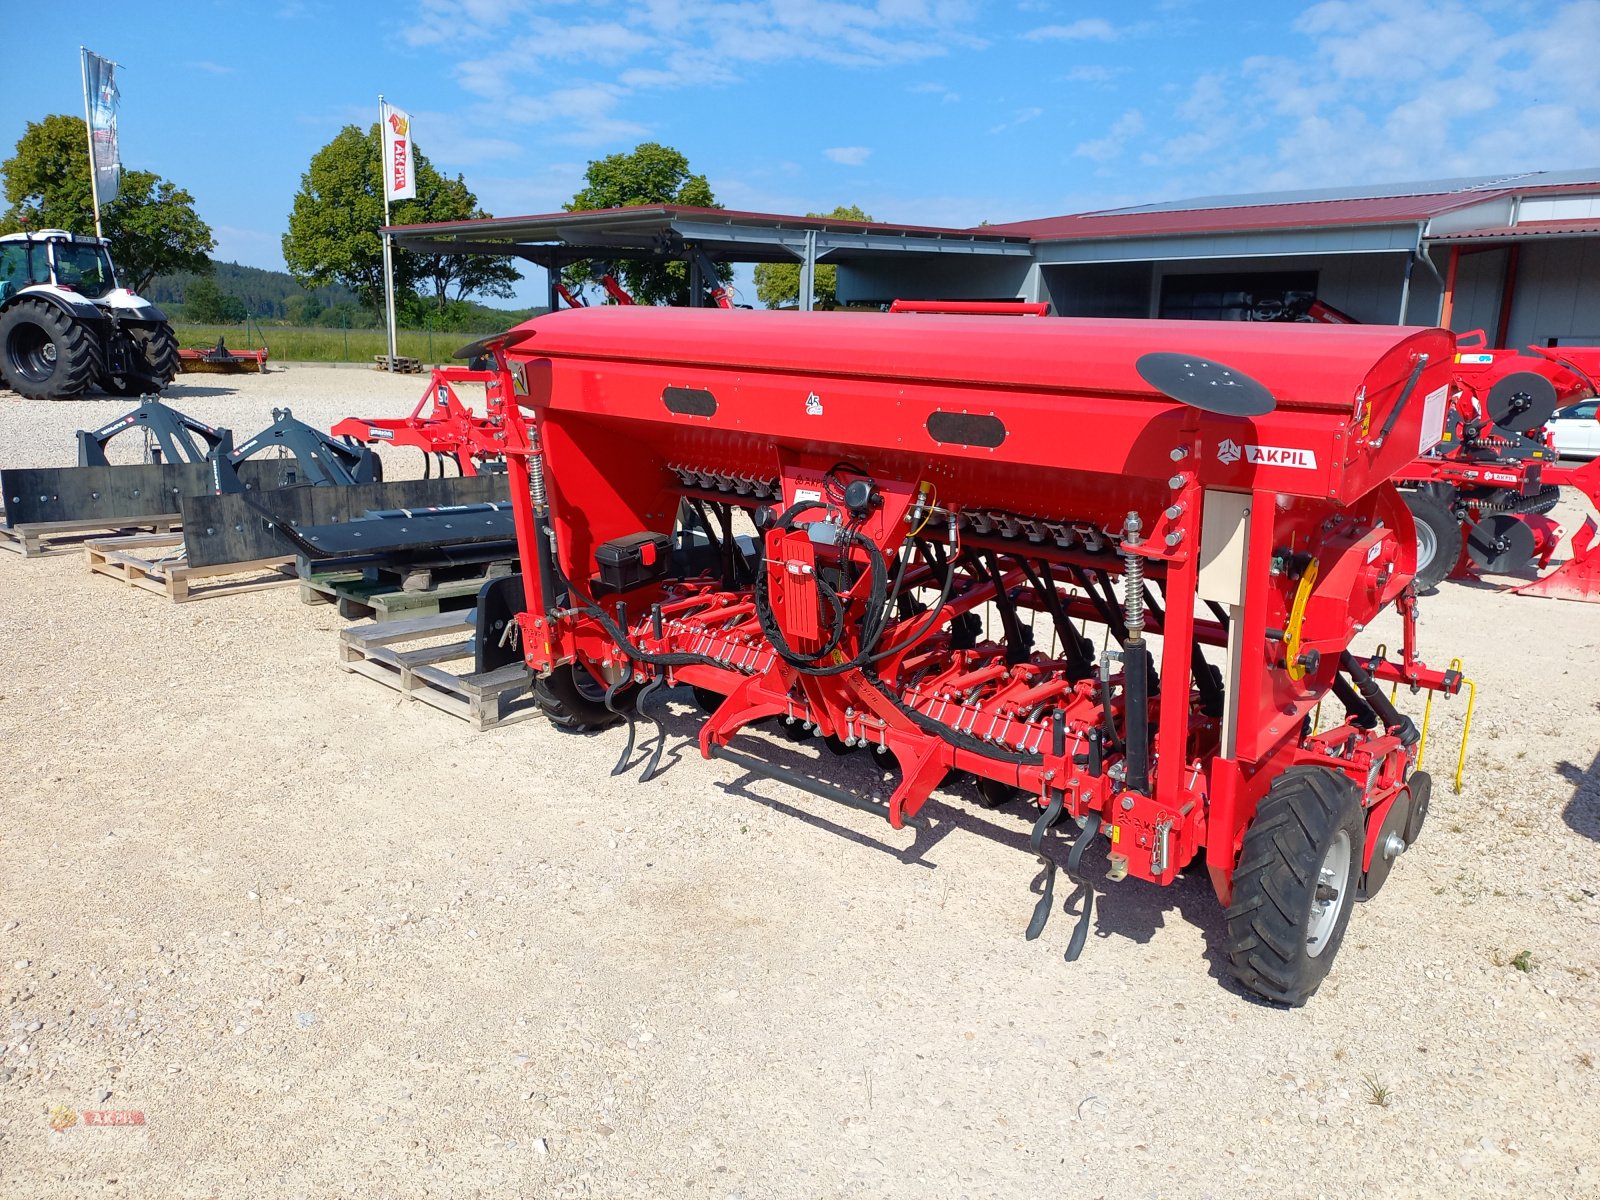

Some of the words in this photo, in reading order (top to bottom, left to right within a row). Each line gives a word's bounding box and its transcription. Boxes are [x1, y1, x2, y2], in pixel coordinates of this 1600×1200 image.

[394, 143, 405, 185] AKPIL
[100, 420, 127, 435] SAPHIR
[1252, 447, 1308, 466] AKPIL
